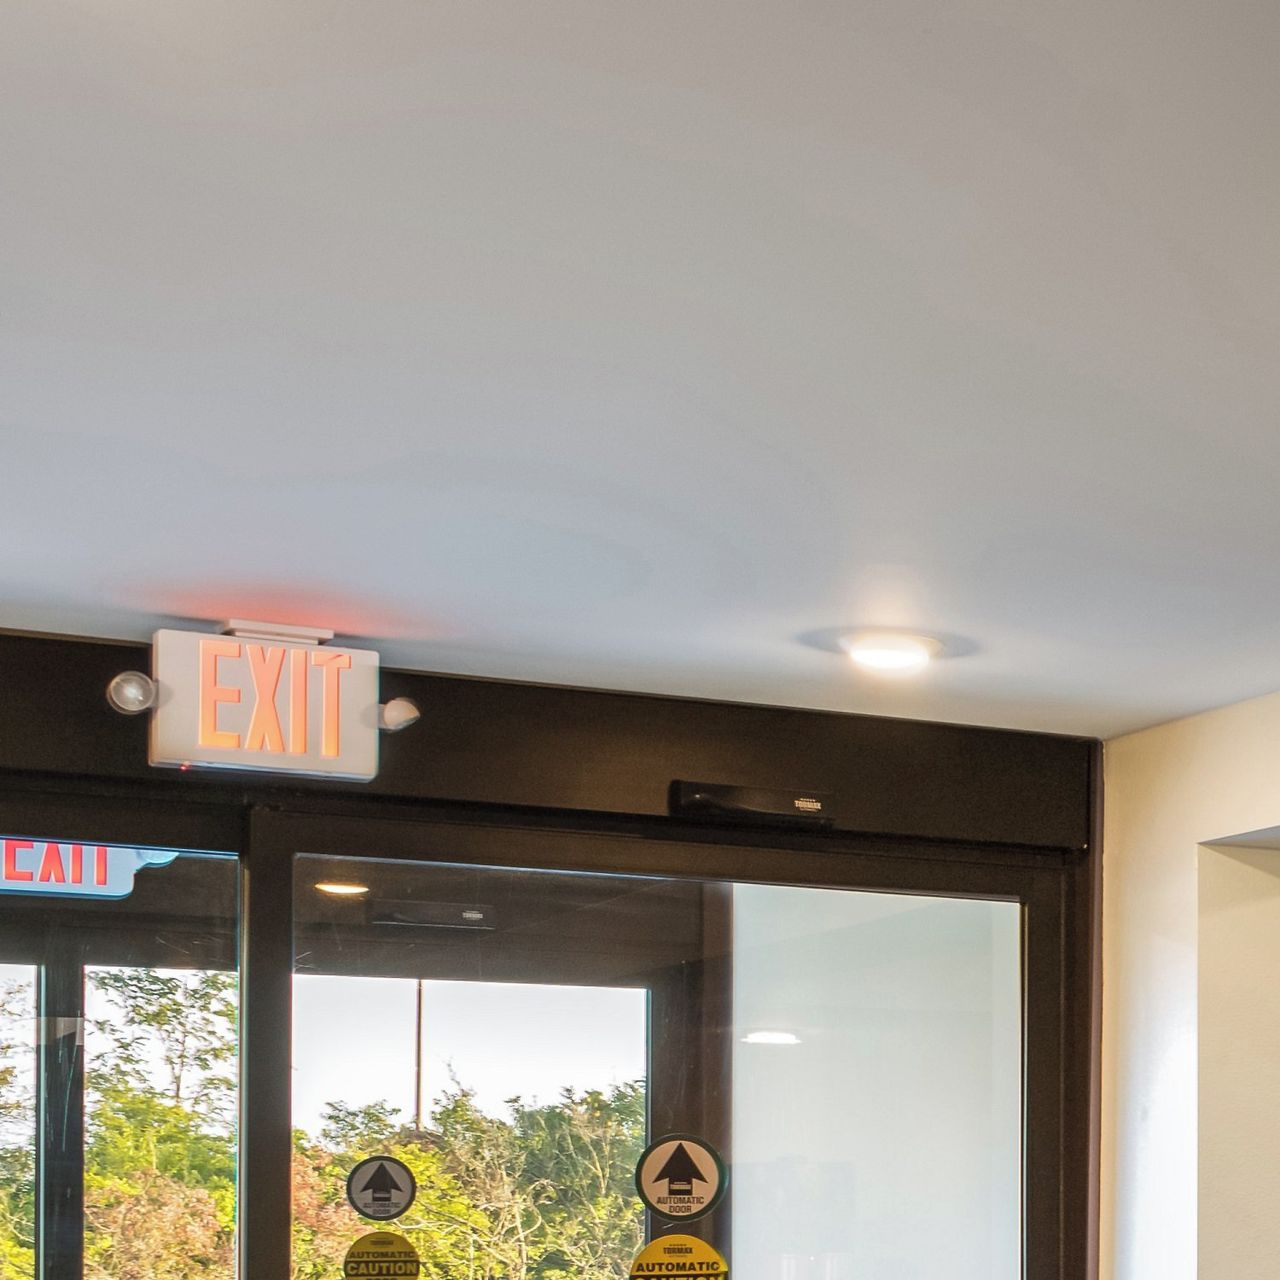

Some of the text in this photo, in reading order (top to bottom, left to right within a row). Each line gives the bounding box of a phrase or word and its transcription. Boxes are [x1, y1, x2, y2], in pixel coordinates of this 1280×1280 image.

[199, 639, 352, 759] EXIT
[656, 1196, 704, 1205] AUTOMATIC
[668, 1205, 692, 1213] DOOR
[348, 1251, 415, 1259] AUTOMATIC
[347, 1262, 417, 1275] CAUTION
[636, 1261, 720, 1273] AUTOMATIC
